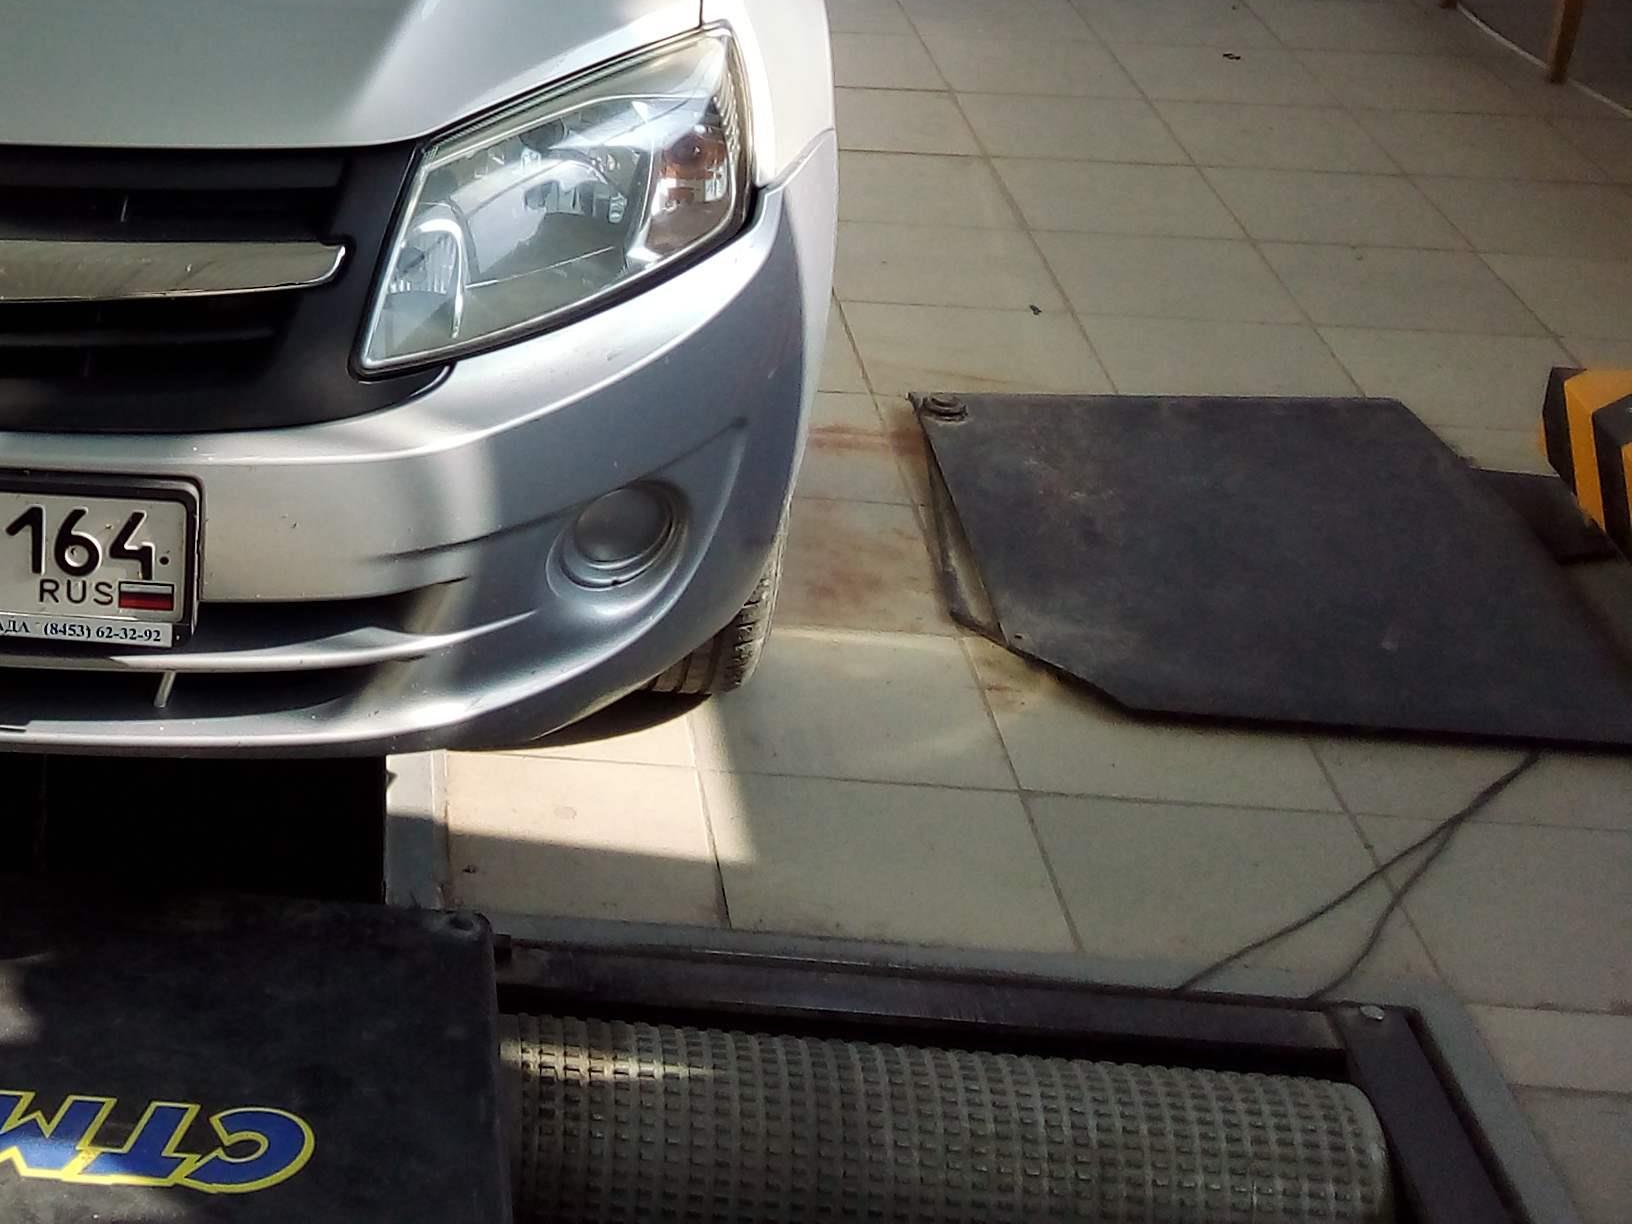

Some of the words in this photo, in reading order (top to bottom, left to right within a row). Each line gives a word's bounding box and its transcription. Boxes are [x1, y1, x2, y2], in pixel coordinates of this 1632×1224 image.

[5, 504, 155, 580] 164
[39, 578, 114, 605] RUS
[43, 622, 92, 639] (8453)
[95, 626, 162, 643] 62-32-92
